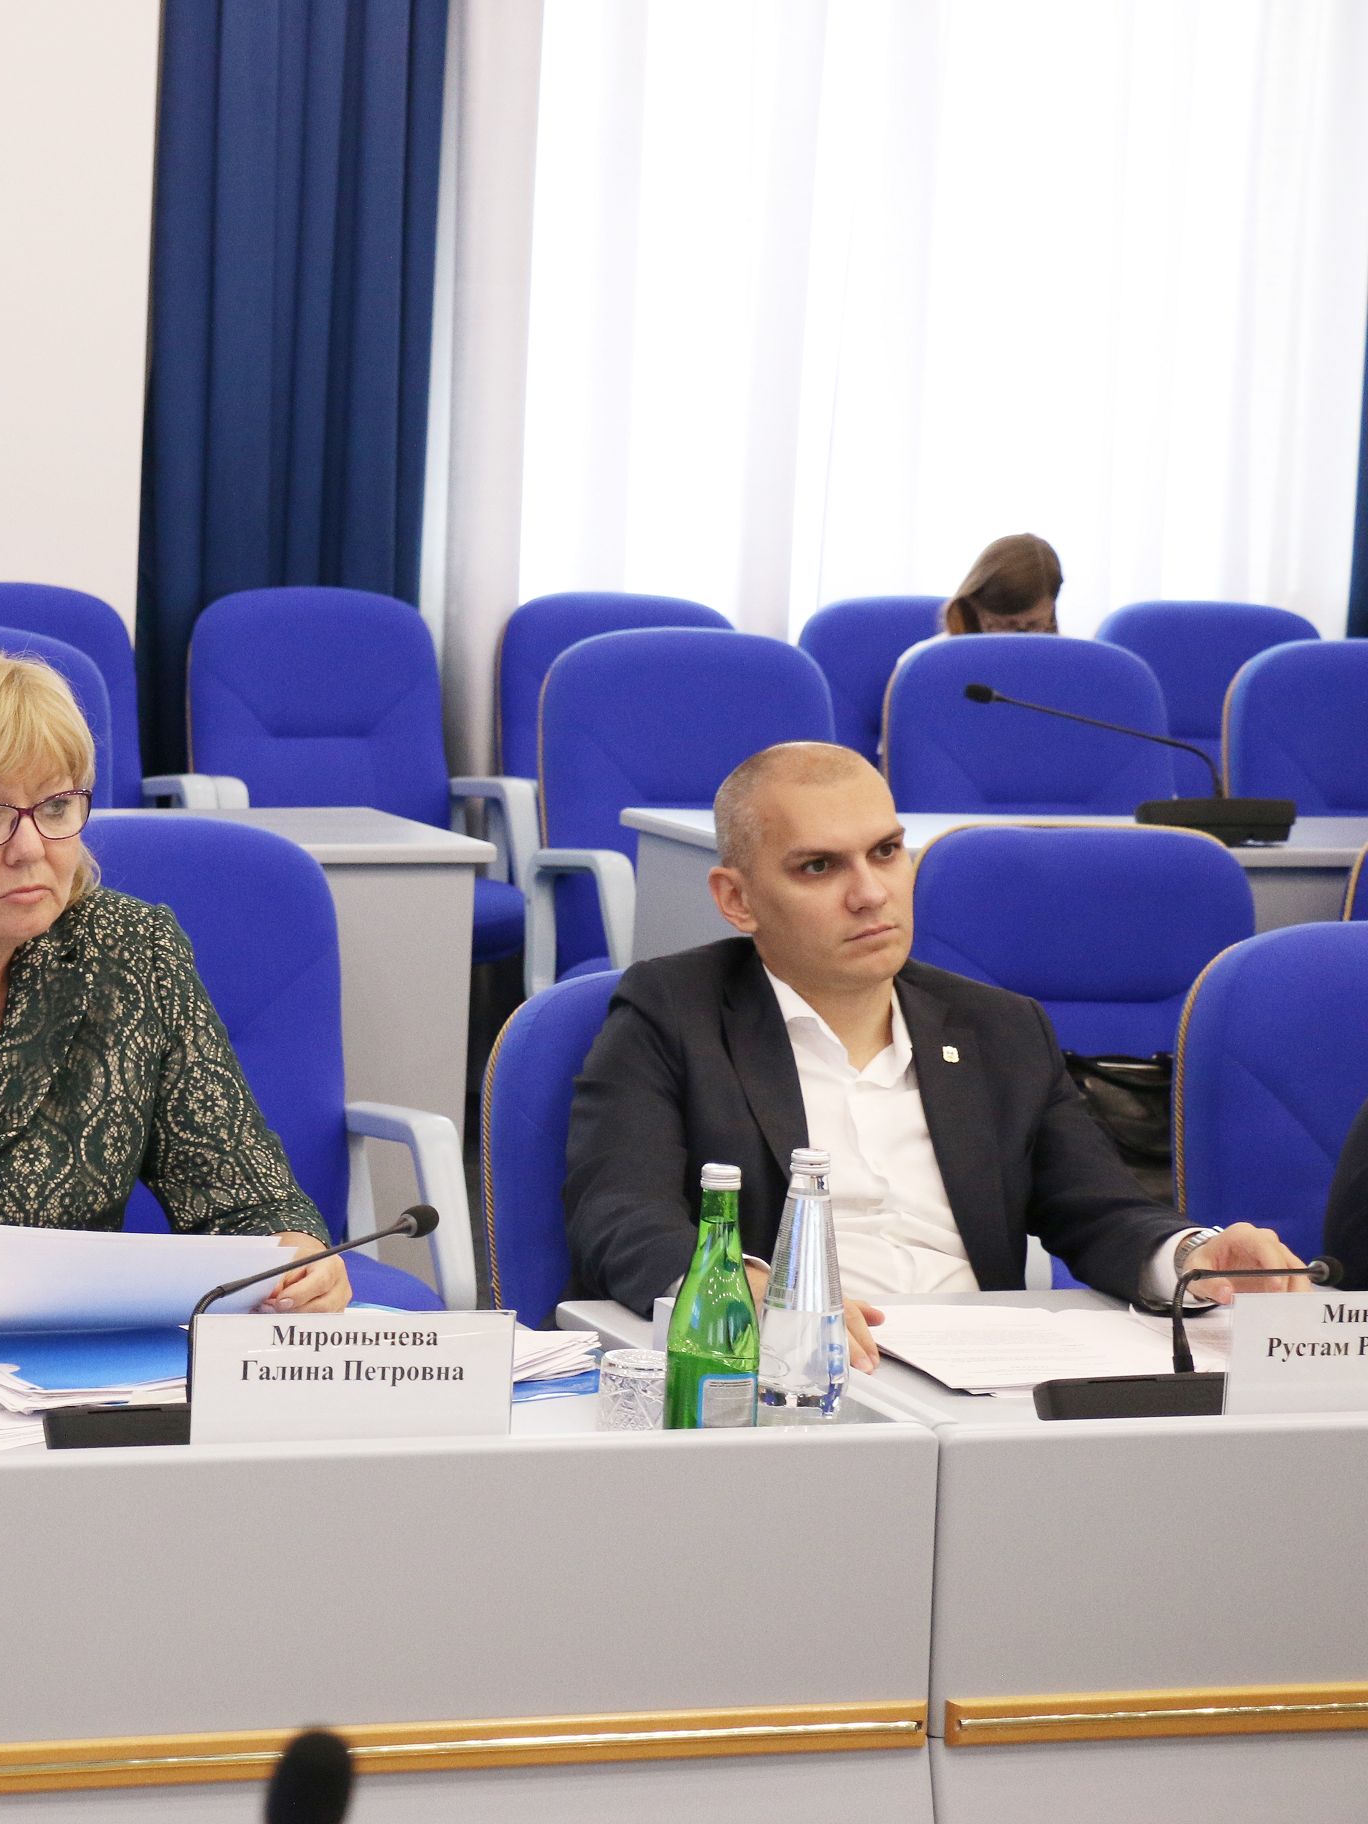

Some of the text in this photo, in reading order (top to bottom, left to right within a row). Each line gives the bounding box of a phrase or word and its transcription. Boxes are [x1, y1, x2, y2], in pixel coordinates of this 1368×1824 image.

[271, 1325, 438, 1352] Миронычева
[1267, 1337, 1350, 1363] Рустам
[241, 1359, 464, 1387] Галина Петровна
